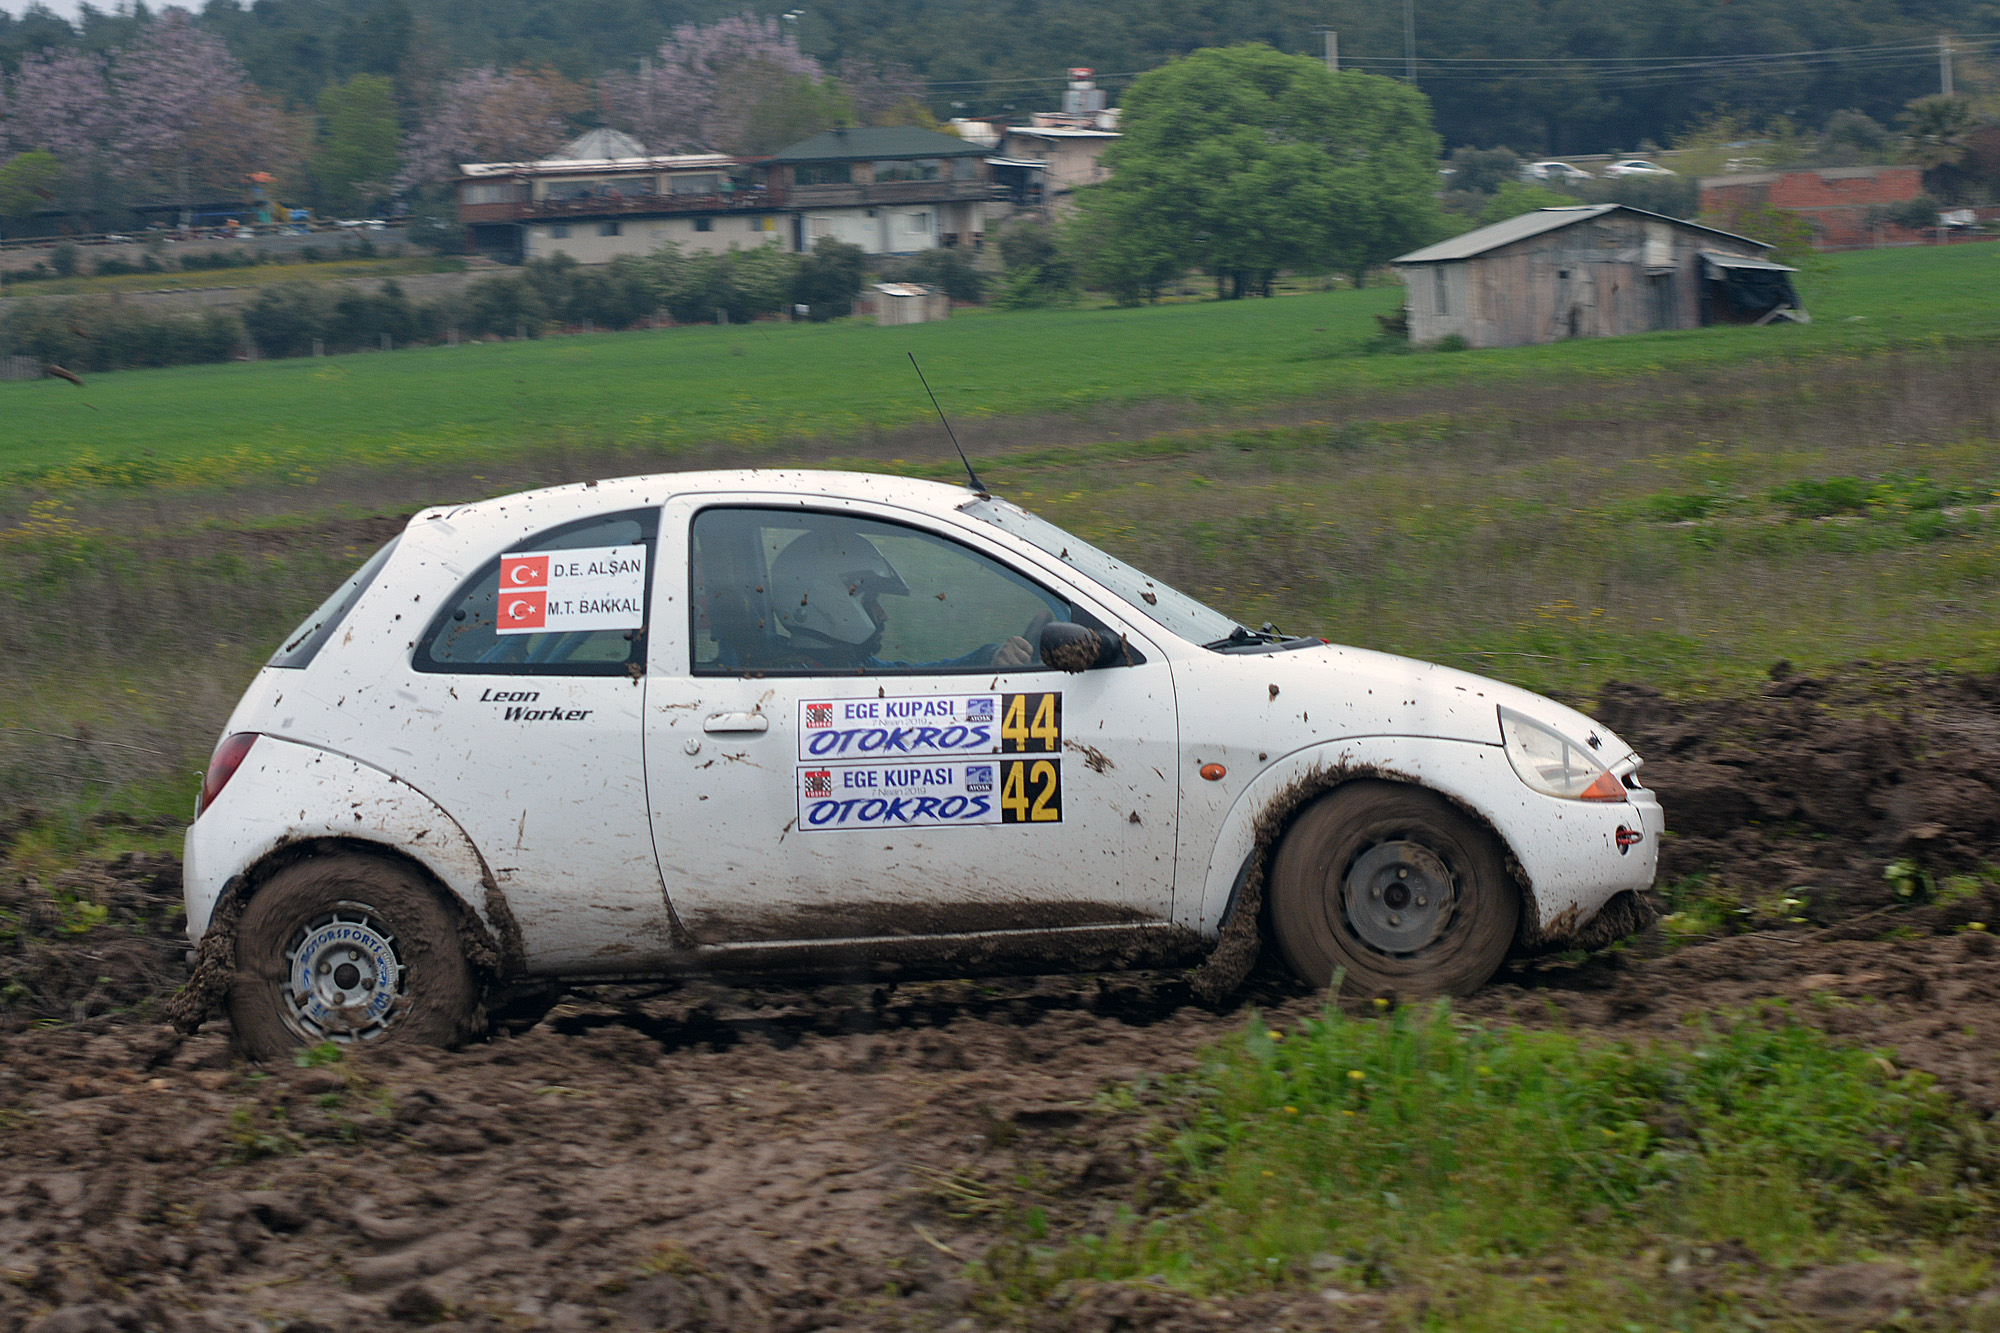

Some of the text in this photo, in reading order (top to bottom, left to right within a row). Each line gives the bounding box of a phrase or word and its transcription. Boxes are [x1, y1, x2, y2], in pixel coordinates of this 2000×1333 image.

[554, 559, 641, 577] D.E. ALŞAN
[548, 598, 641, 615] M.T. BAKKAL
[480, 688, 540, 702] Leon
[504, 706, 593, 720] Worker
[845, 701, 954, 719] EGE KUPASI
[1001, 693, 1059, 751] 44
[805, 725, 991, 755] OTOKROS
[843, 768, 953, 788] EGE KUPASI
[1001, 760, 1059, 821] 42
[805, 795, 991, 825] OTOKROS
[300, 928, 382, 964] MOTORSPORTS
